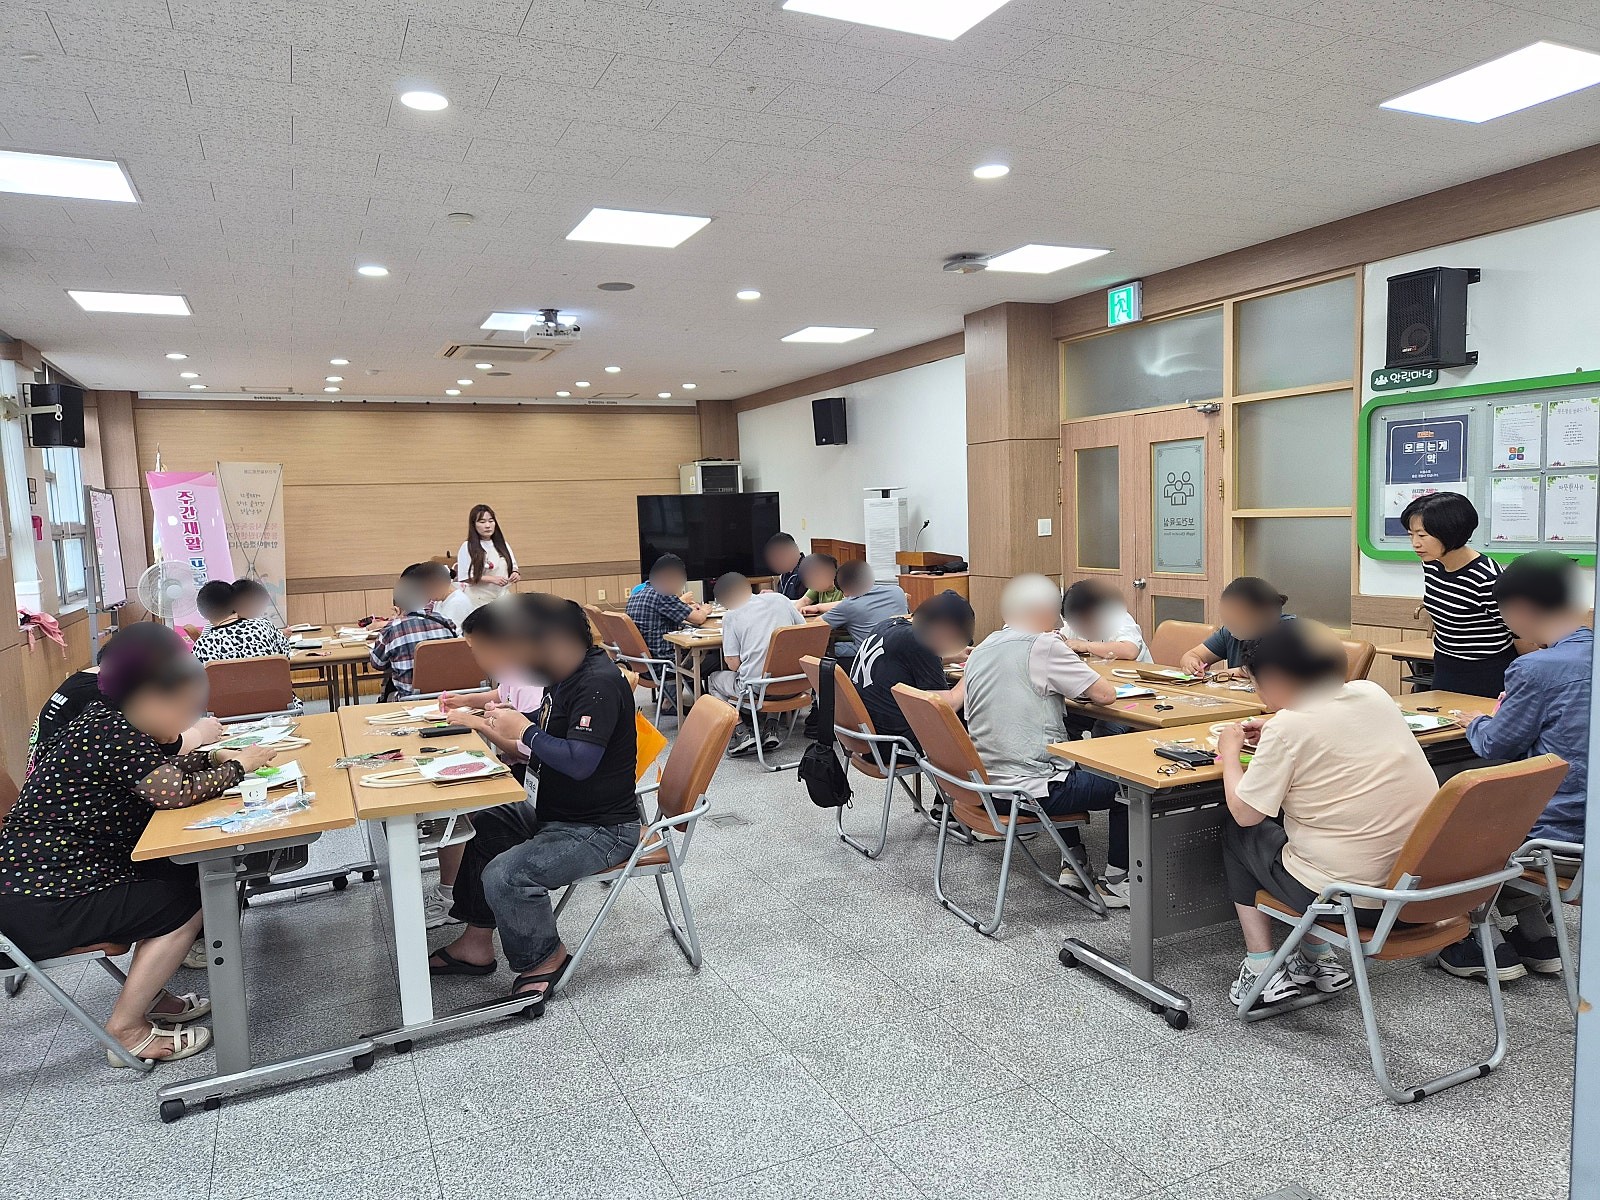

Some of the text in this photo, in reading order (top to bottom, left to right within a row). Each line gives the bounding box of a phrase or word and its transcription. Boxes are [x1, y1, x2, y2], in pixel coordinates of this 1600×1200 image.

[1404, 440, 1448, 453] 모르는게
[1427, 454, 1436, 463] 약
[177, 489, 202, 551] 주간재활
[850, 633, 885, 688] NY
